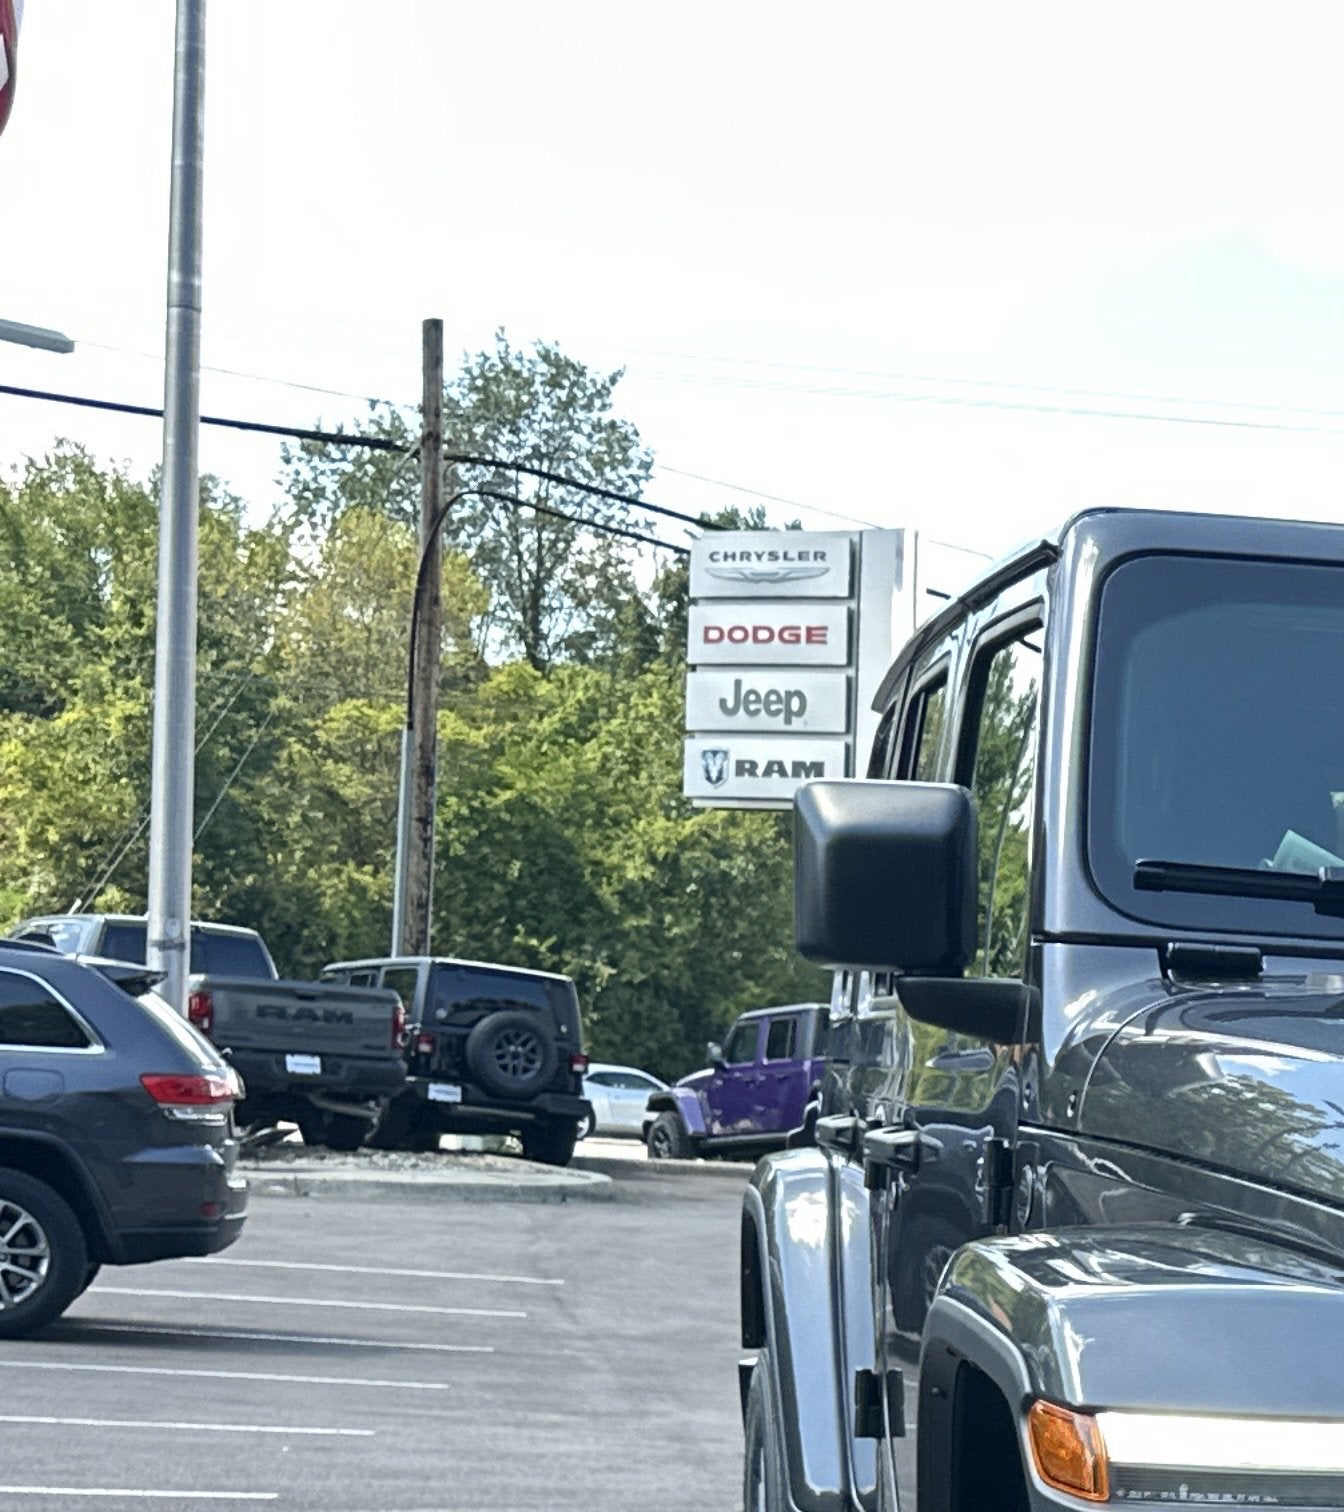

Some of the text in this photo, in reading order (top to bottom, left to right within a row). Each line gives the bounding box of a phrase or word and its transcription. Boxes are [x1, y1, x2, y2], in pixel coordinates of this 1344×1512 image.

[708, 550, 827, 563] CHRYSLER
[703, 625, 829, 645] DODGE
[718, 678, 808, 726] Jeep
[735, 759, 825, 779] RAM
[256, 1004, 354, 1025] RAM
